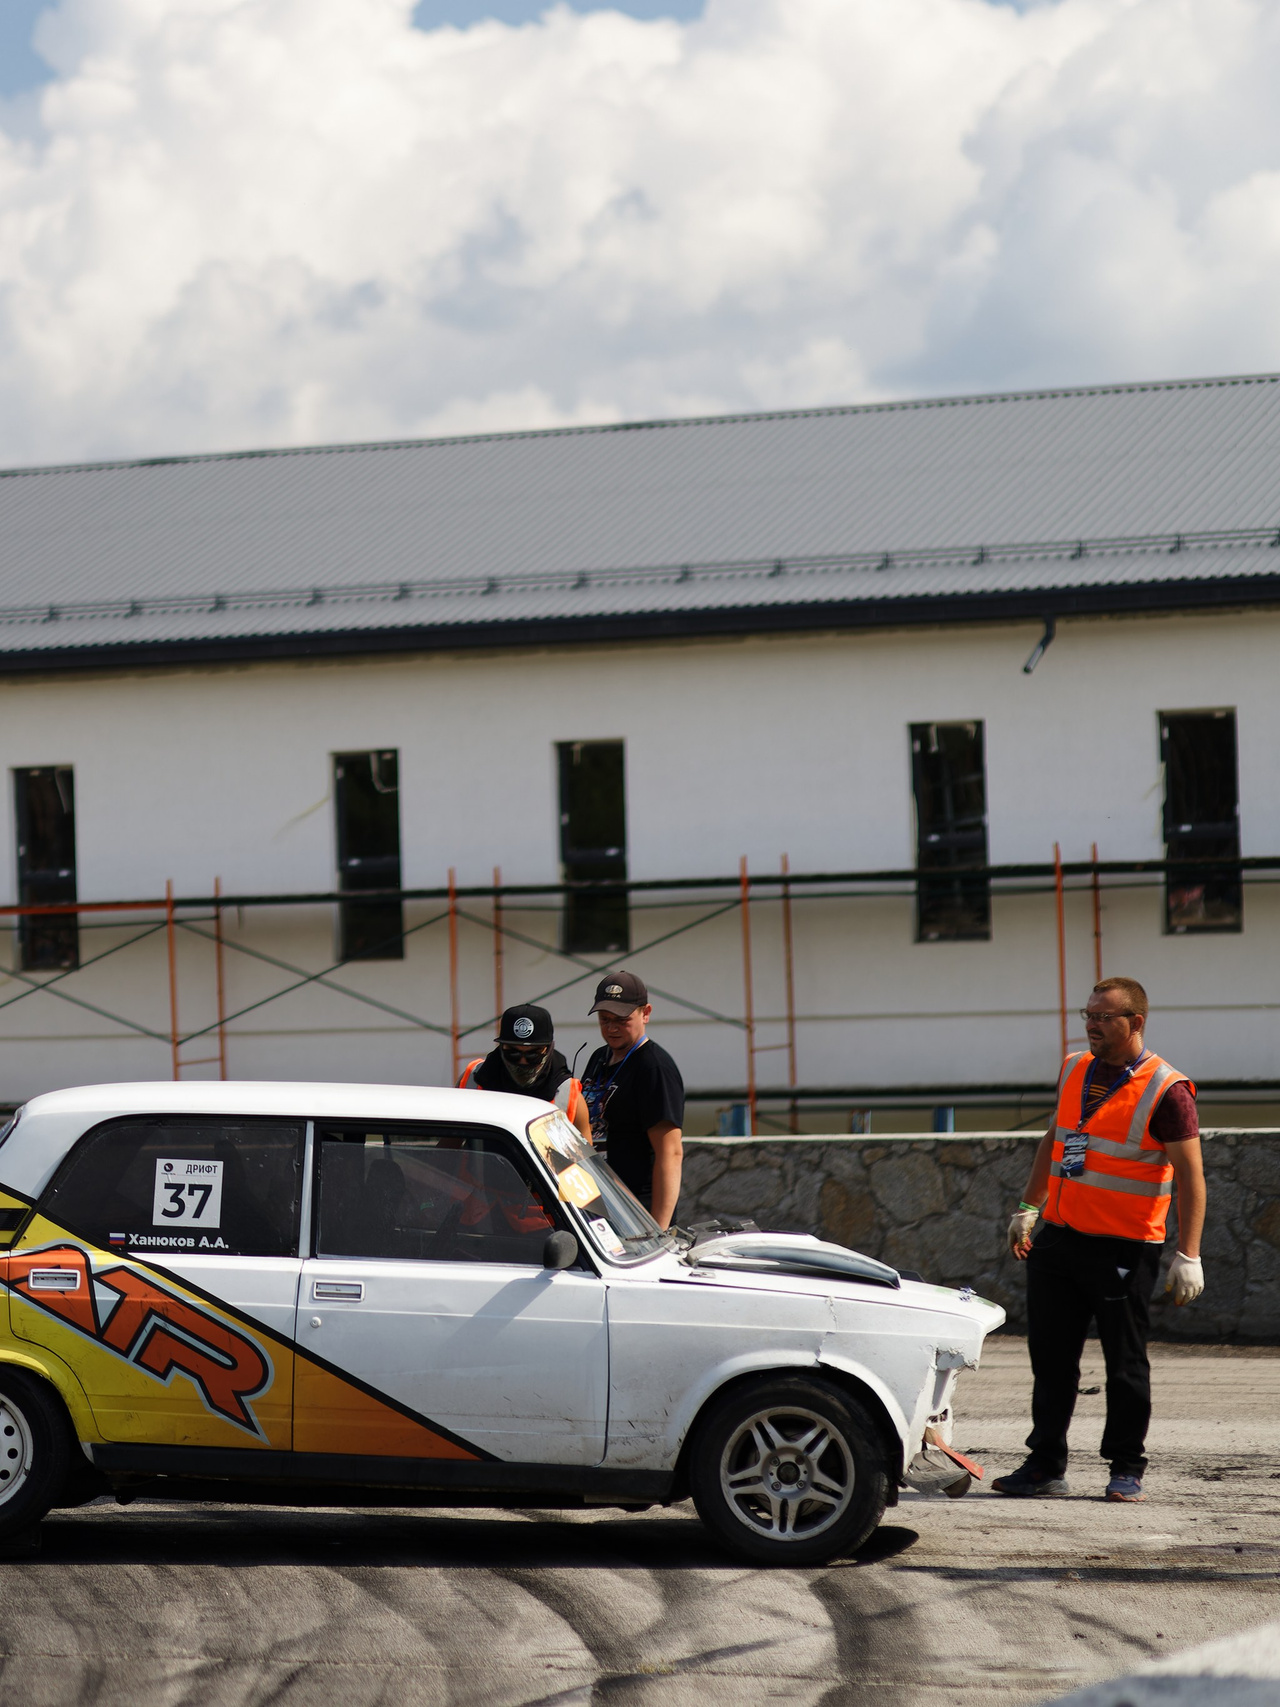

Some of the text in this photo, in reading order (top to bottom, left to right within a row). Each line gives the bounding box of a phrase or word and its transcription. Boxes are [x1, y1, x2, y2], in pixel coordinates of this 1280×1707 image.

[185, 1164, 218, 1175] ДРИФТ
[564, 1167, 594, 1201] 37
[161, 1182, 213, 1219] 37
[128, 1233, 229, 1249] Ханюков А.А.
